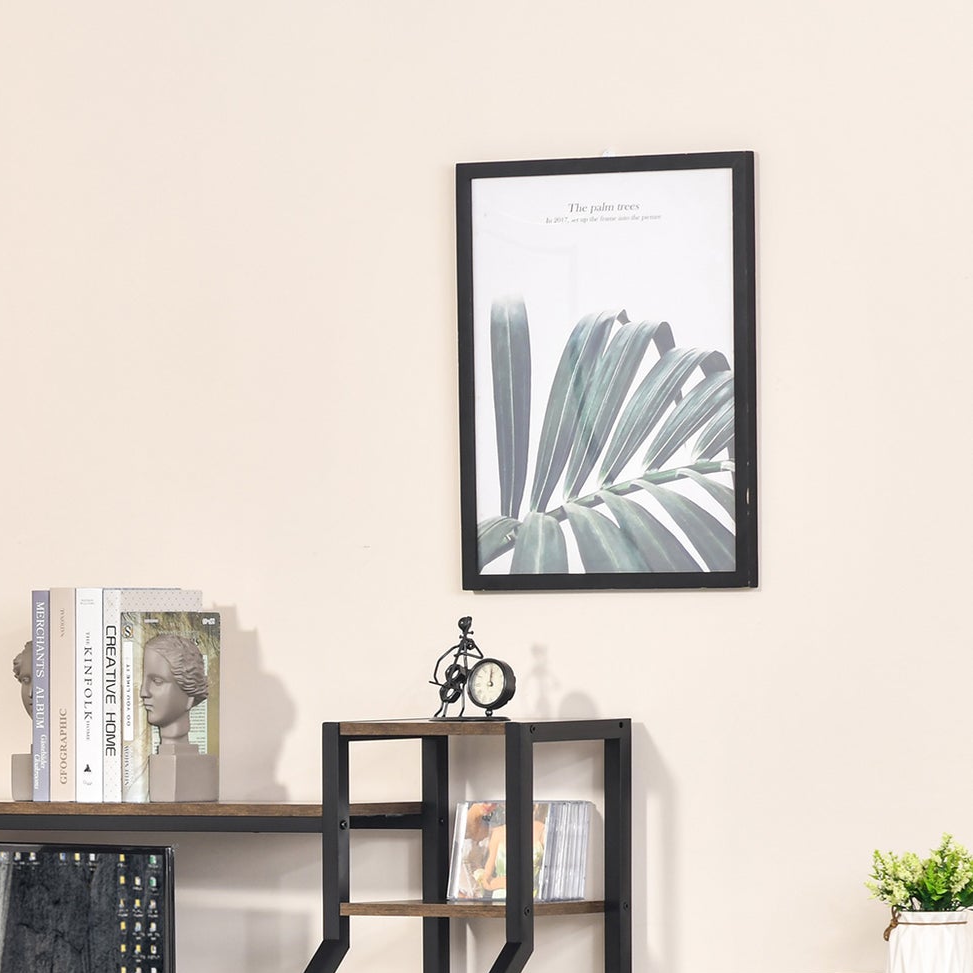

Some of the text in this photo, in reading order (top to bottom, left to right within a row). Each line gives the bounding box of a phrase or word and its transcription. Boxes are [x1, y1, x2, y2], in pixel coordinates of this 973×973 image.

[568, 202, 641, 214] The palm trees
[35, 601, 45, 729] MERCHANTS ALBUM
[83, 646, 93, 720] KINFOLK
[105, 625, 117, 757] CREATIVE HOME
